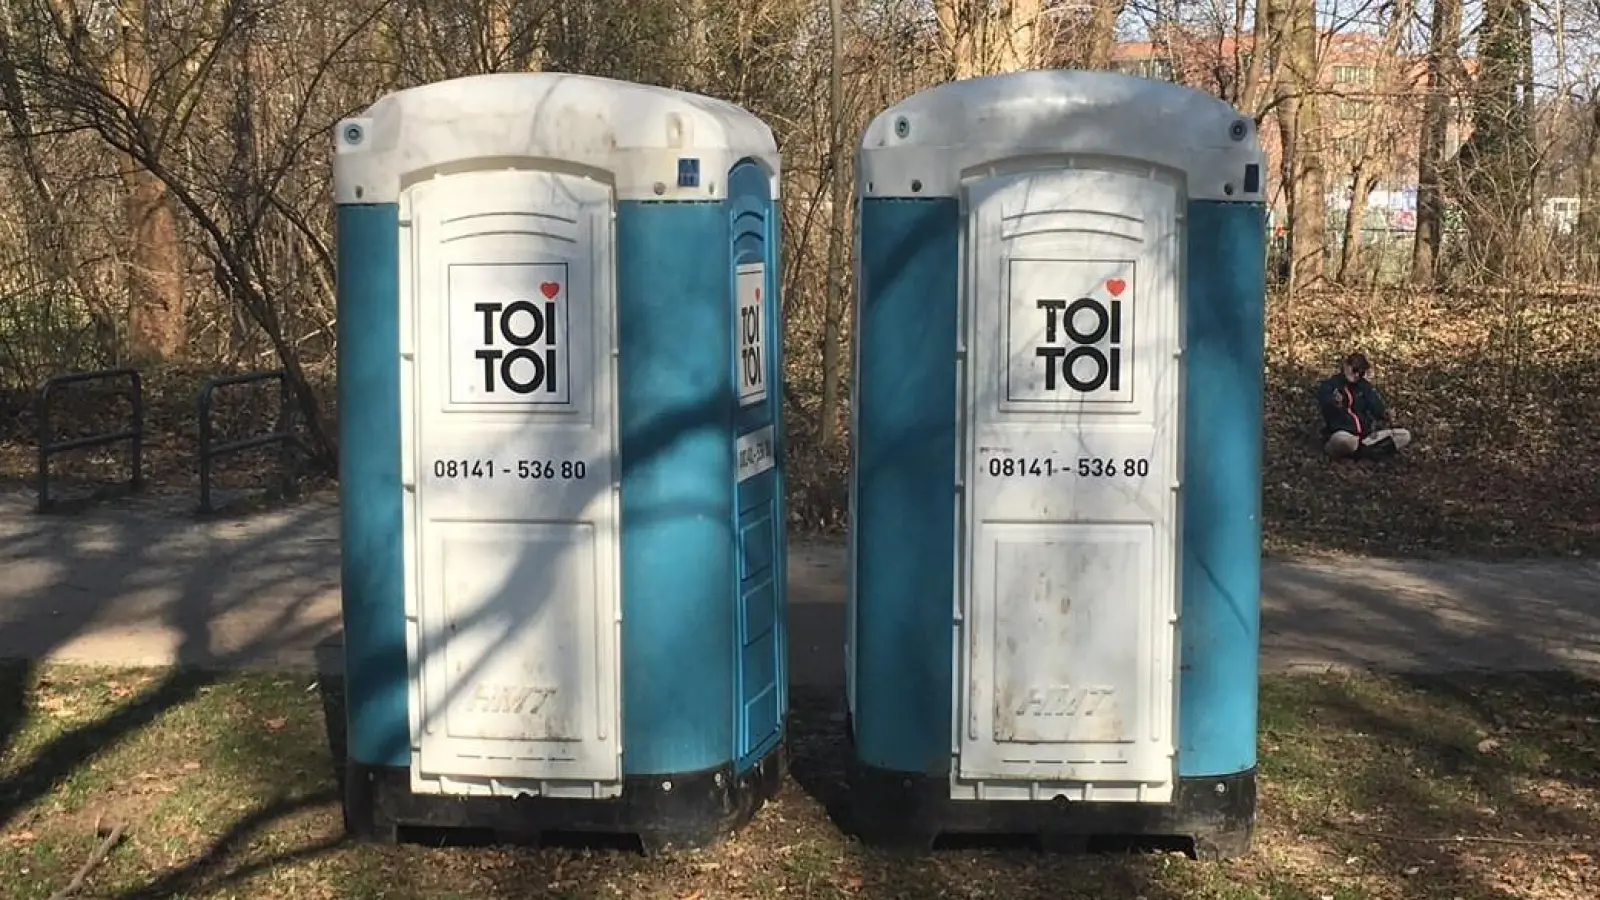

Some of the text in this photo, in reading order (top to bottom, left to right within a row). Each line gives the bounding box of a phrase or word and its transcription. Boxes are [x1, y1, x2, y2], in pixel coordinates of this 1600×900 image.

[474, 300, 557, 347] TOI
[741, 304, 760, 345] TOI
[1037, 297, 1122, 345] TOI
[475, 347, 557, 394] TOI
[741, 347, 762, 387] TOI
[1035, 344, 1121, 393] TOI
[434, 460, 494, 478] 08141
[518, 461, 556, 480] 536
[561, 461, 587, 480] 80
[989, 457, 1053, 477] 08141
[1077, 458, 1117, 477] 536
[1123, 458, 1149, 477] 80
